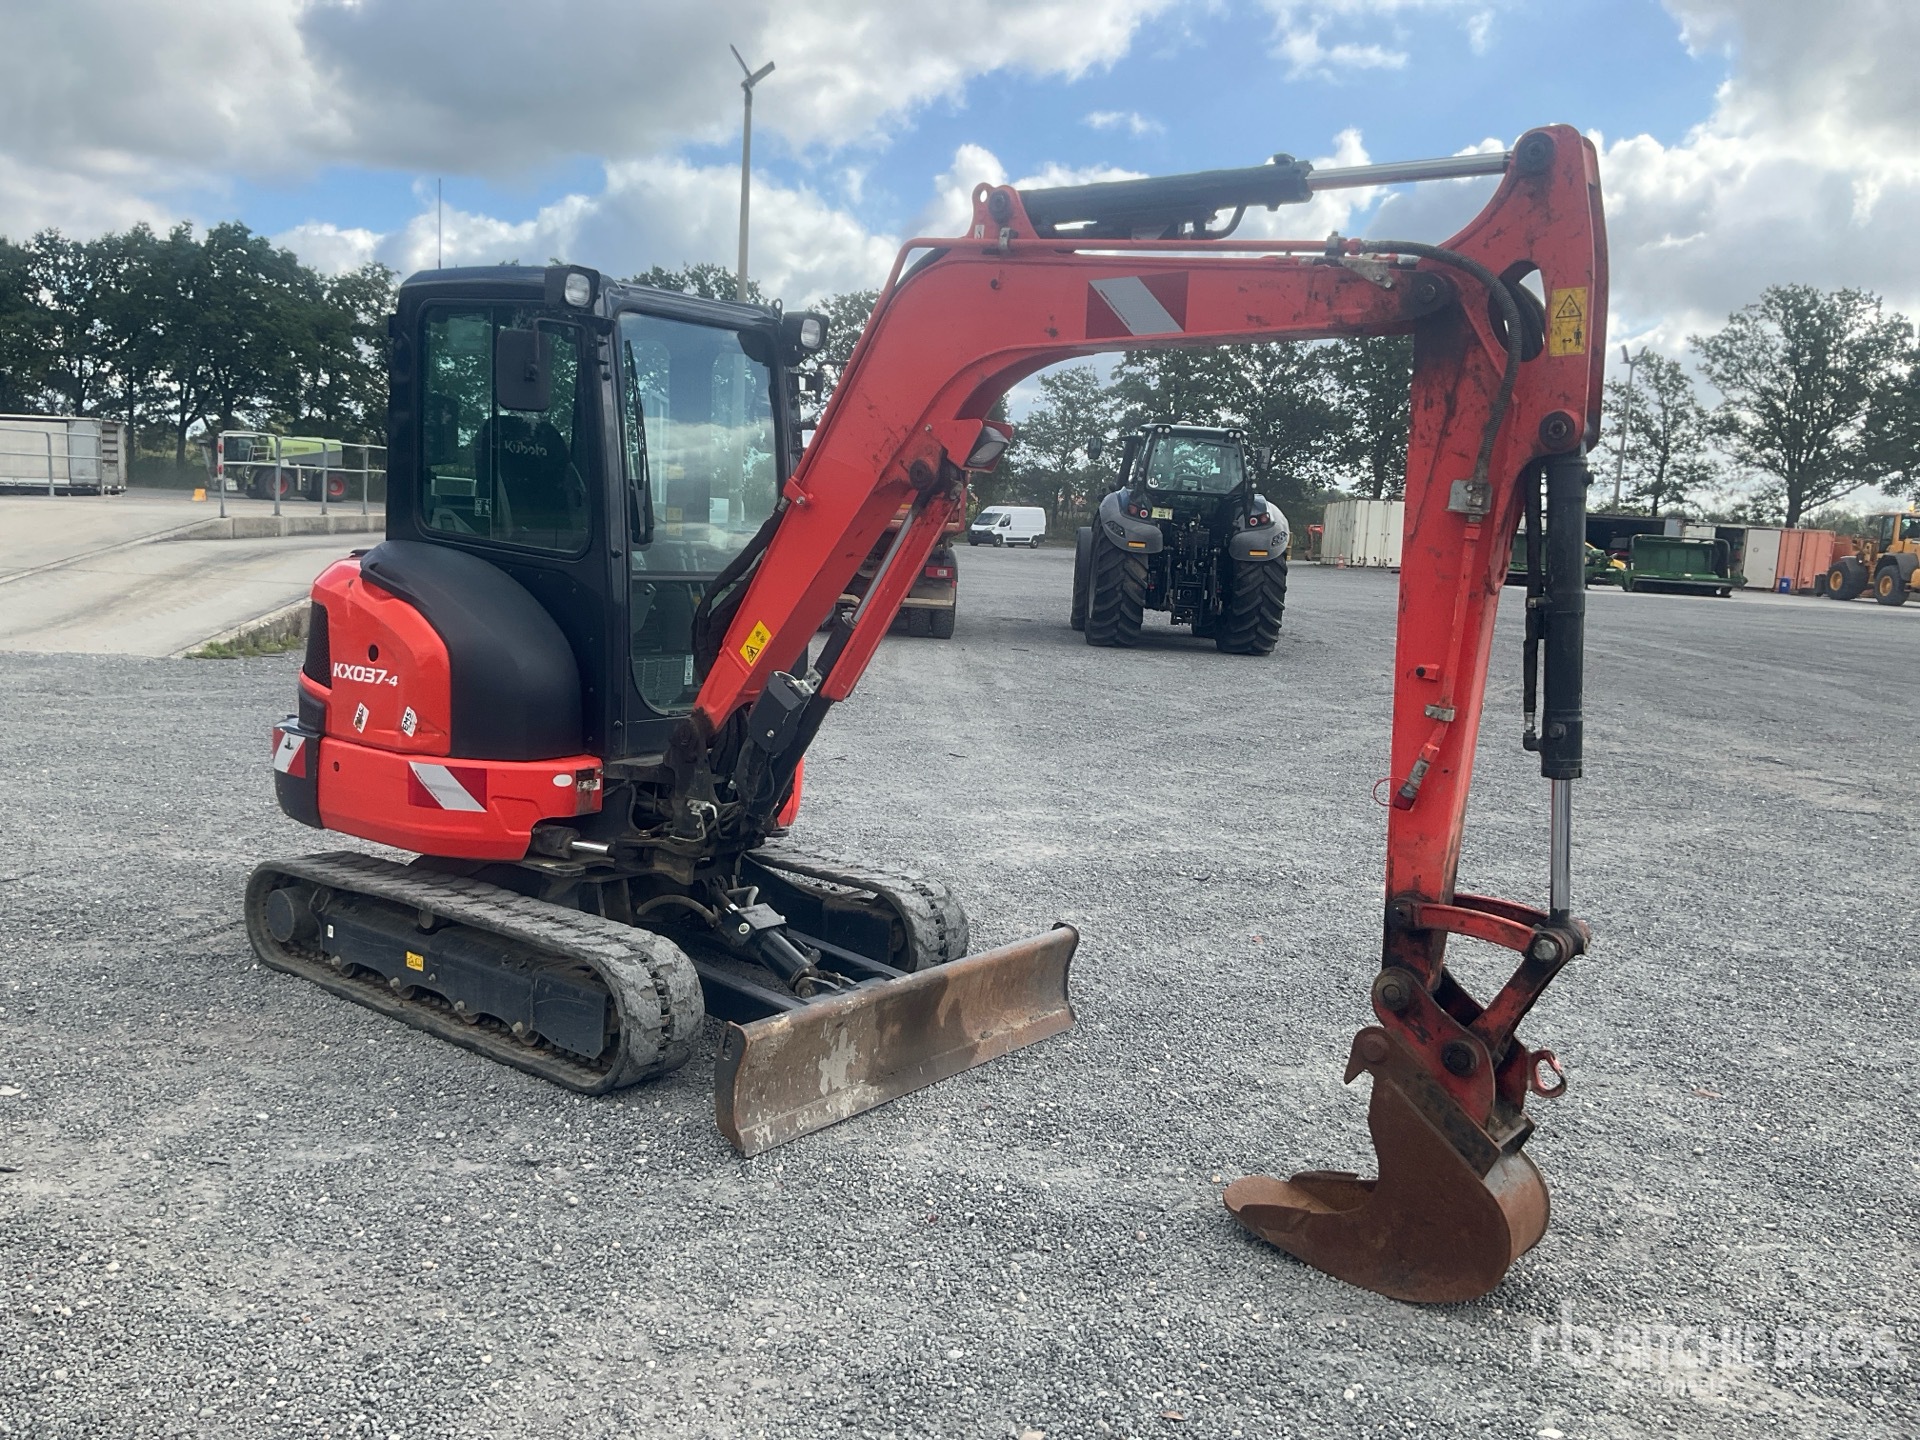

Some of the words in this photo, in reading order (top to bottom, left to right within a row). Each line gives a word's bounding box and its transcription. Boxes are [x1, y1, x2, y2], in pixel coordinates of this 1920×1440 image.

[504, 440, 548, 456] Kubota
[333, 662, 399, 687] KX037-4
[402, 710, 414, 731] EMS
